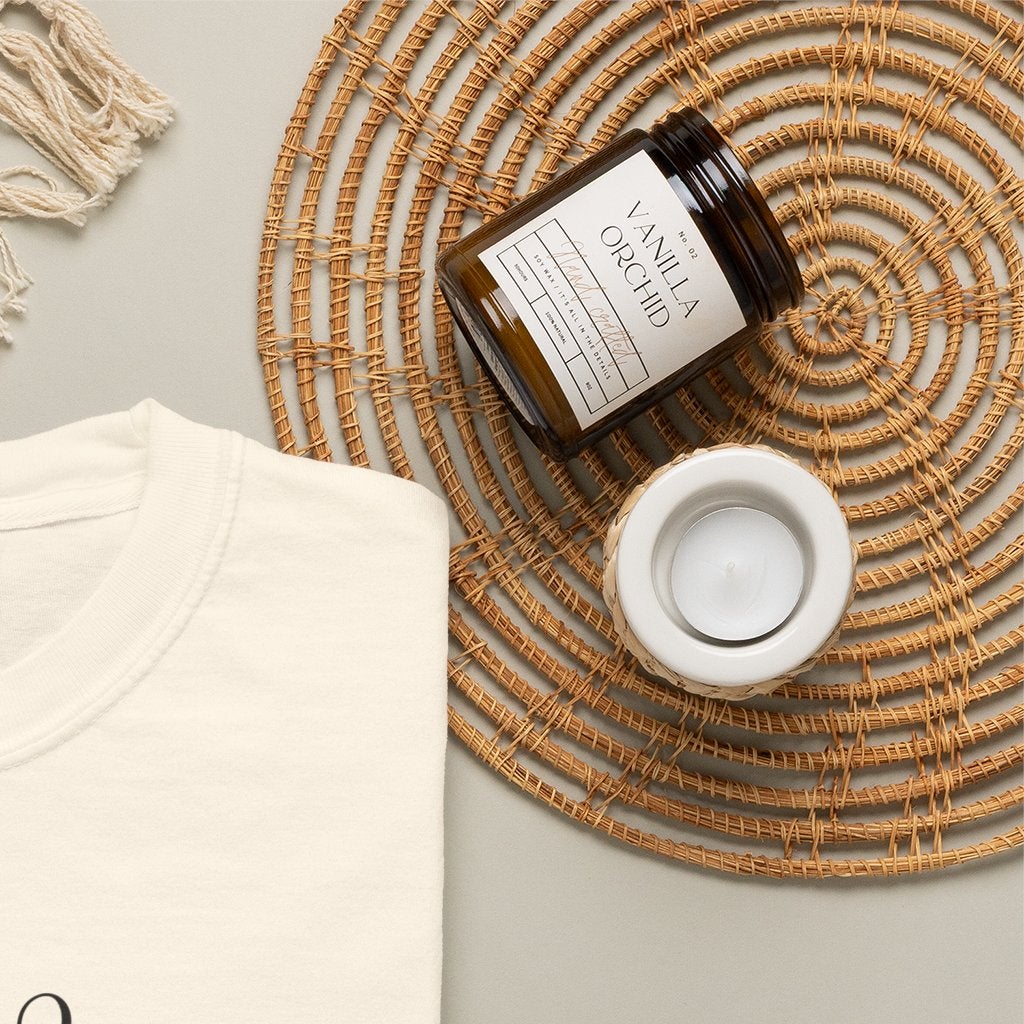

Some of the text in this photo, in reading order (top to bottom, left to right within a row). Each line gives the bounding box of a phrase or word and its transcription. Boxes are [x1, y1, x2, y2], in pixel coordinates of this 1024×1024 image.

[600, 225, 671, 329] ORCHID
[626, 200, 701, 319] VANILLA
[688, 247, 699, 260] 02
[533, 254, 545, 267] SOY
[543, 268, 555, 283] WAX
[568, 308, 579, 323] ALL
[577, 324, 586, 334] IN
[584, 335, 595, 350] THE
[593, 351, 611, 380] DETAILS
[552, 323, 567, 345] NATURAL
